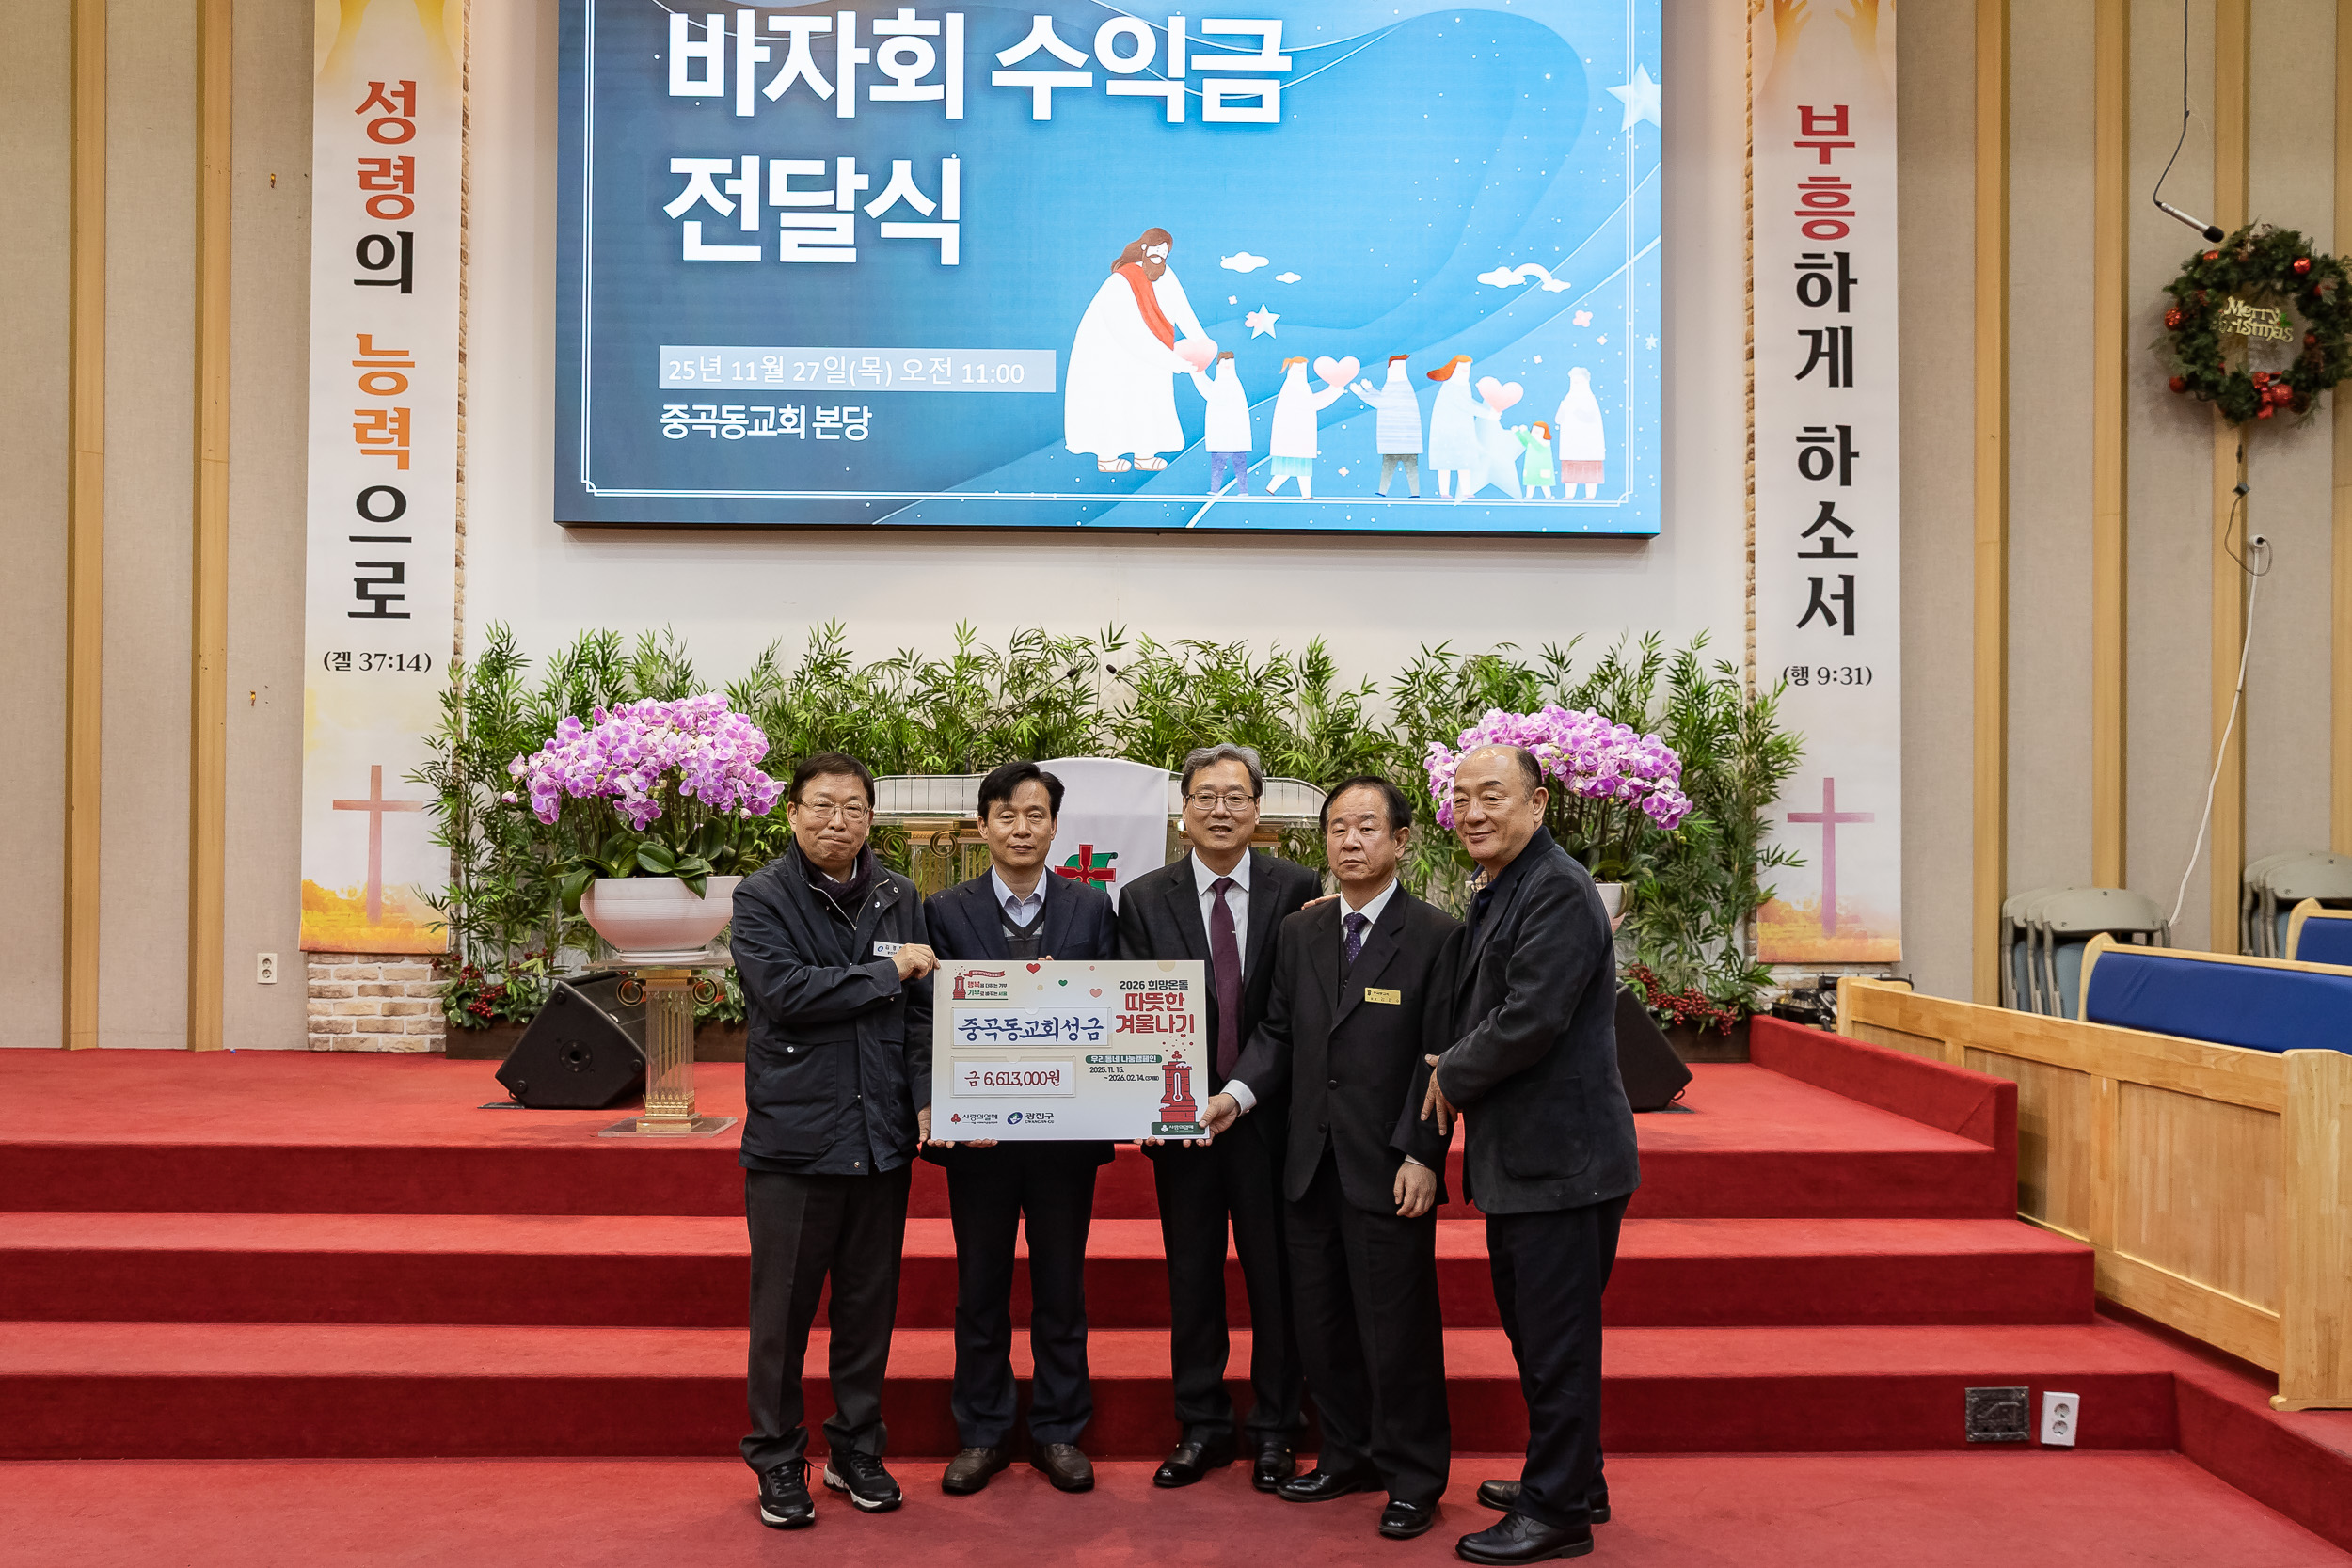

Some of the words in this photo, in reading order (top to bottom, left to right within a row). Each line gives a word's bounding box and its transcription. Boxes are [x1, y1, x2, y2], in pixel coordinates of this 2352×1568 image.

[667, 9, 964, 120] 바자회
[991, 13, 1293, 125] 수익금
[353, 79, 417, 294] 성령의
[662, 155, 961, 267] 전달식
[1792, 103, 1859, 388] 부흥하게
[2223, 295, 2281, 324] Merry
[668, 354, 723, 383] 25년
[730, 355, 785, 384] 11월
[792, 355, 893, 388] 27일(목)
[899, 356, 953, 386] 오전
[961, 363, 1025, 385] 11:00
[660, 404, 806, 440] 중곡동교회
[812, 405, 873, 441] 본당
[347, 333, 416, 620] 능력으로
[1794, 423, 1860, 637] 하소서
[323, 650, 352, 672] (겔
[358, 652, 433, 673] 37:14)
[1783, 665, 1810, 687] (행
[1817, 665, 1873, 687] 9:31)
[1120, 980, 1146, 990] 2026
[1148, 979, 1189, 990] 희망온돌
[1124, 991, 1185, 1012] 따뜻한
[1115, 1013, 1195, 1034] 겨울나기
[964, 1070, 980, 1087] 금
[983, 1069, 1060, 1087] 6,613,000원
[1025, 1112, 1055, 1120] 광진구
